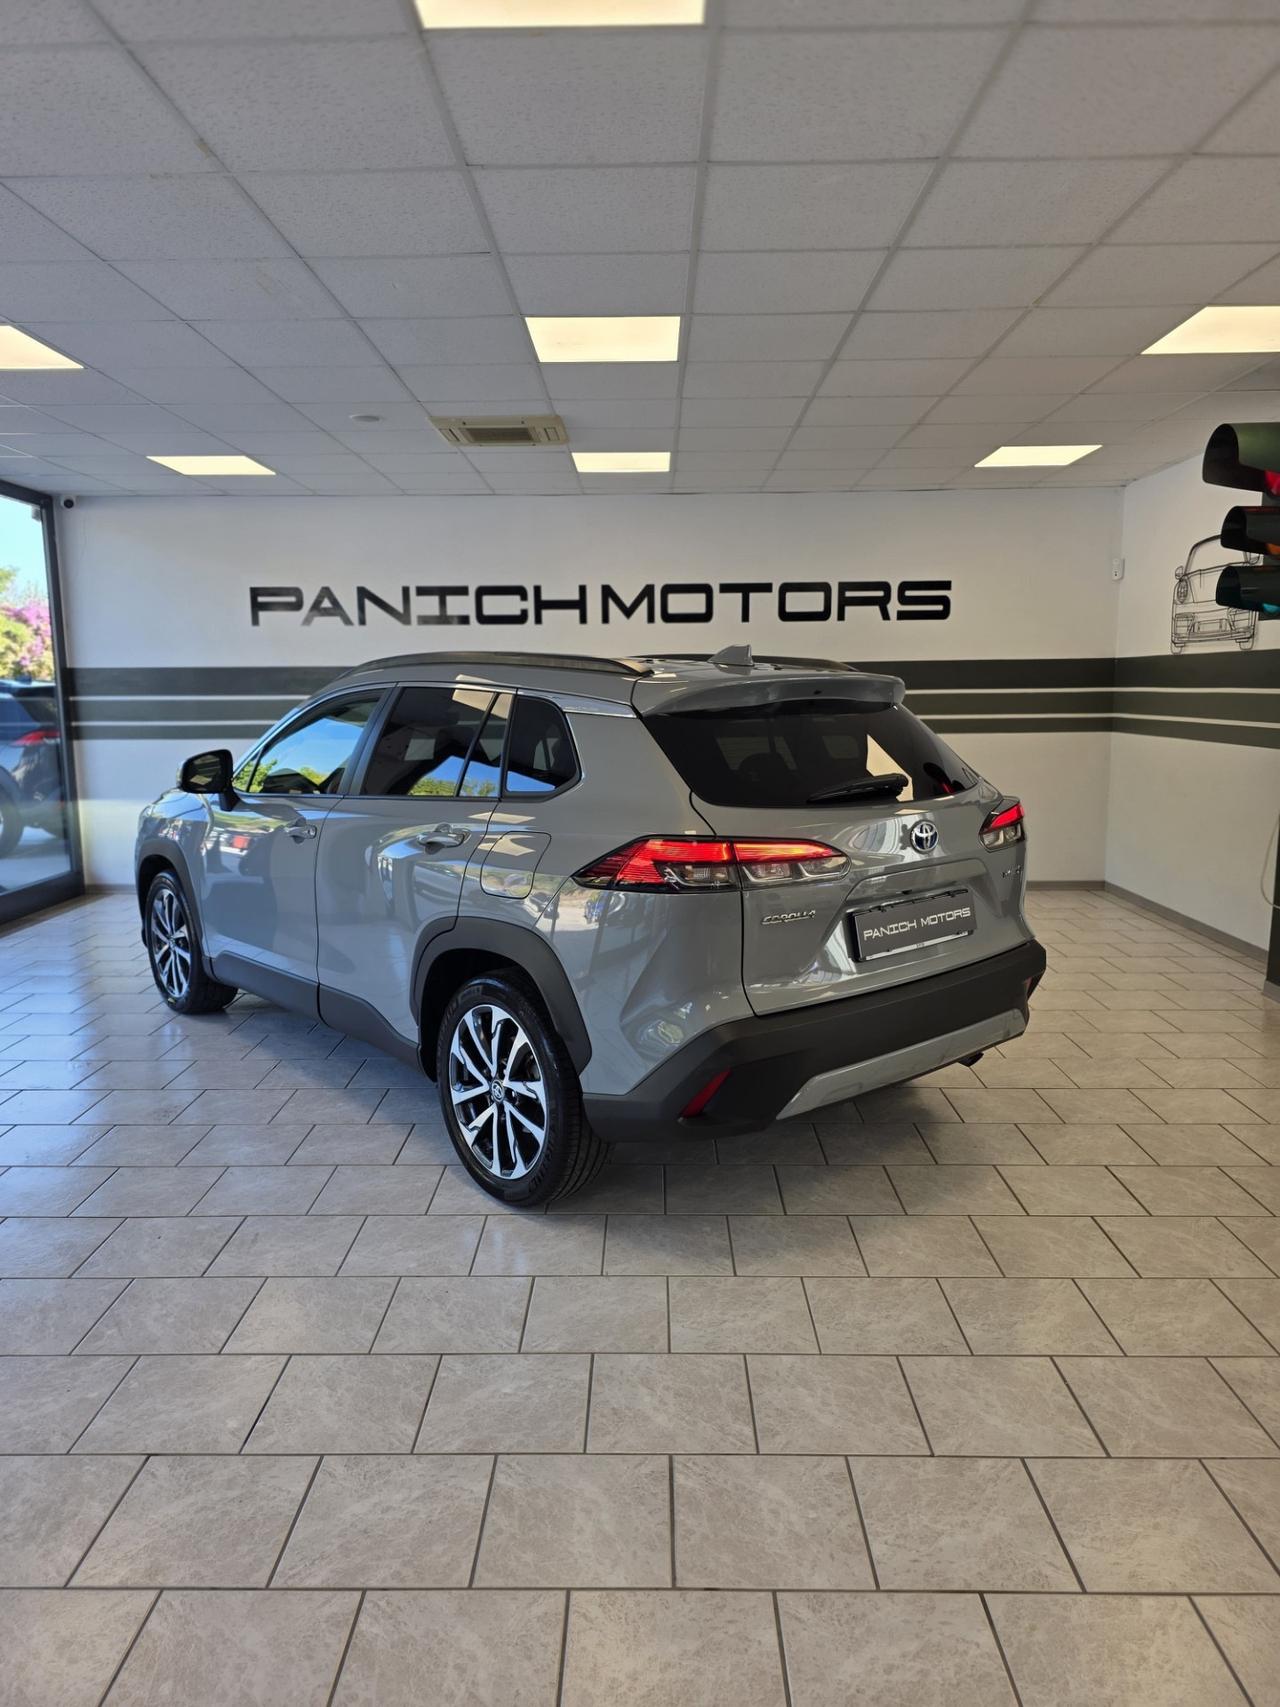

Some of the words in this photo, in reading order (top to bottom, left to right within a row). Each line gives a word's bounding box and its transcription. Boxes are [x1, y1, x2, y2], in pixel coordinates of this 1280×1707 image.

[249, 583, 588, 626] PANICH
[600, 580, 953, 625] MOTORS
[863, 919, 918, 941] PANICH
[920, 906, 972, 927] MOTORS
